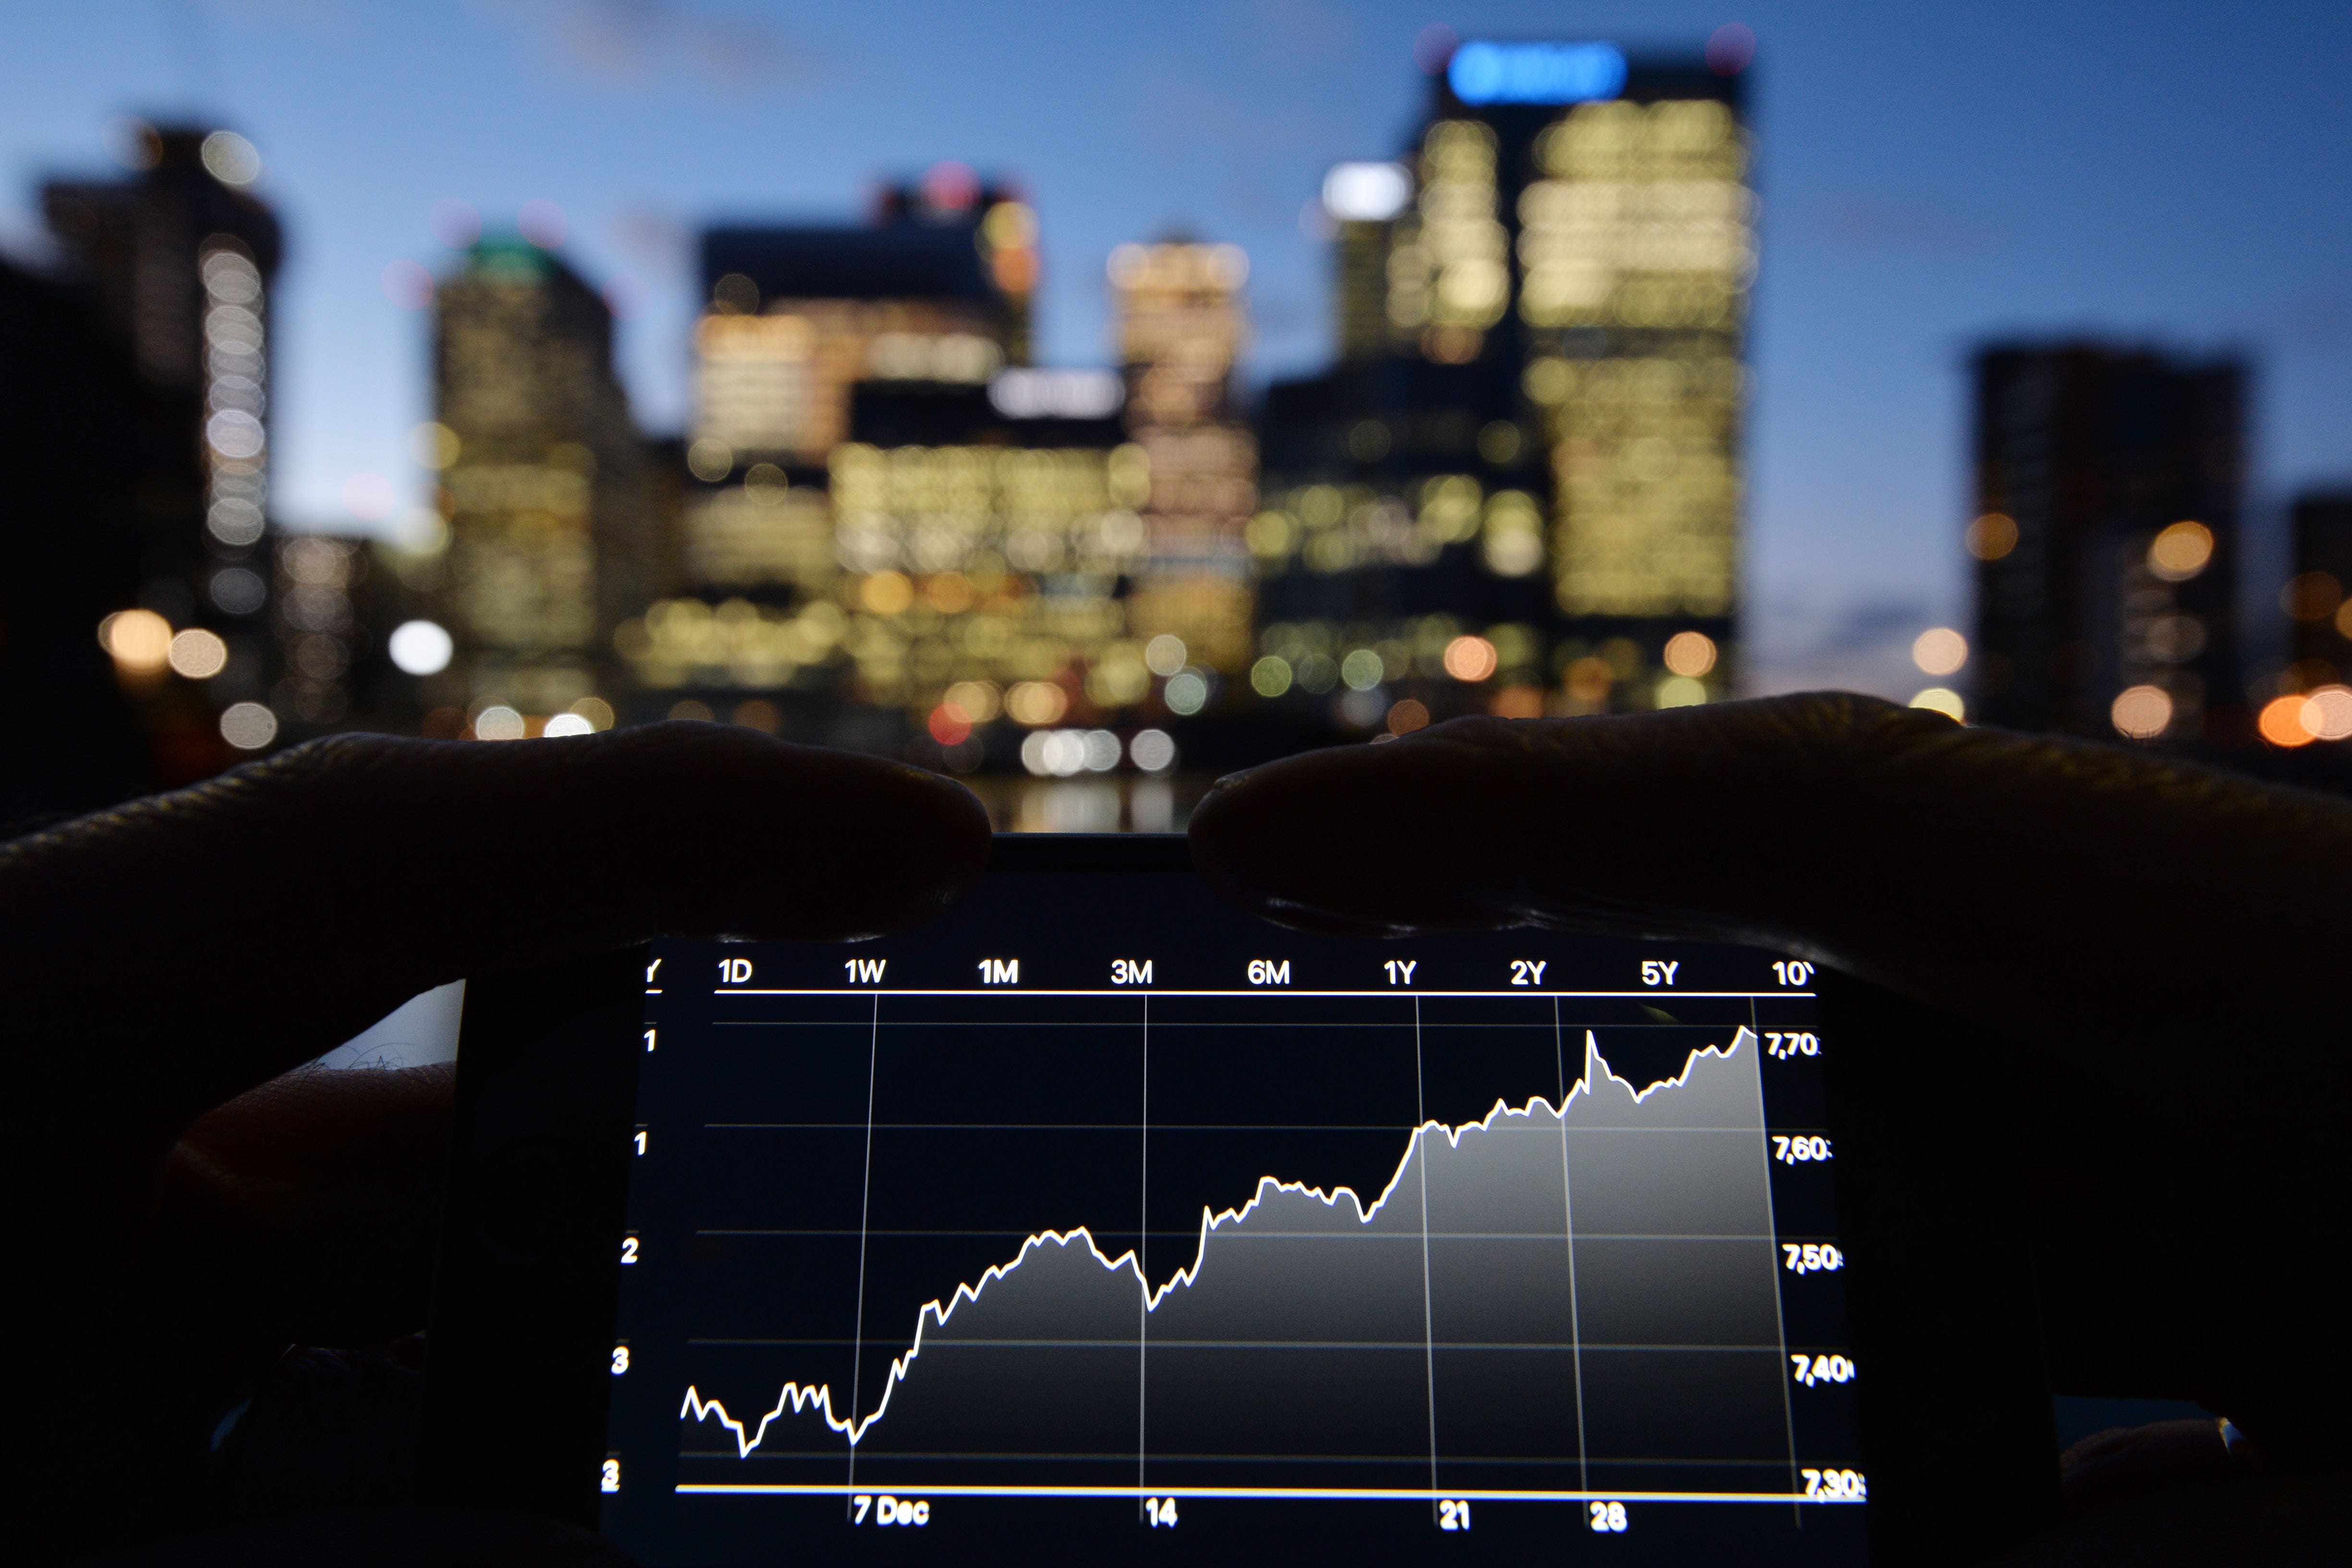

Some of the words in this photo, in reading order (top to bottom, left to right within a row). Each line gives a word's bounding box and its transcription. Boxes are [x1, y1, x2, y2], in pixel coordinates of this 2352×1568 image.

[719, 959, 752, 982] 1D
[845, 960, 886, 983] 1W
[978, 960, 1018, 983] 1M
[1111, 960, 1152, 984] 3M
[1248, 960, 1289, 984] 6M
[1384, 960, 1416, 984] 1Y
[1511, 960, 1546, 985] 2Y
[1642, 961, 1678, 985] 5Y
[854, 1495, 871, 1524] 7
[877, 1495, 929, 1525] Dec
[1146, 1497, 1178, 1527] 14
[1439, 1499, 1470, 1530] 21
[1590, 1501, 1627, 1532] 28
